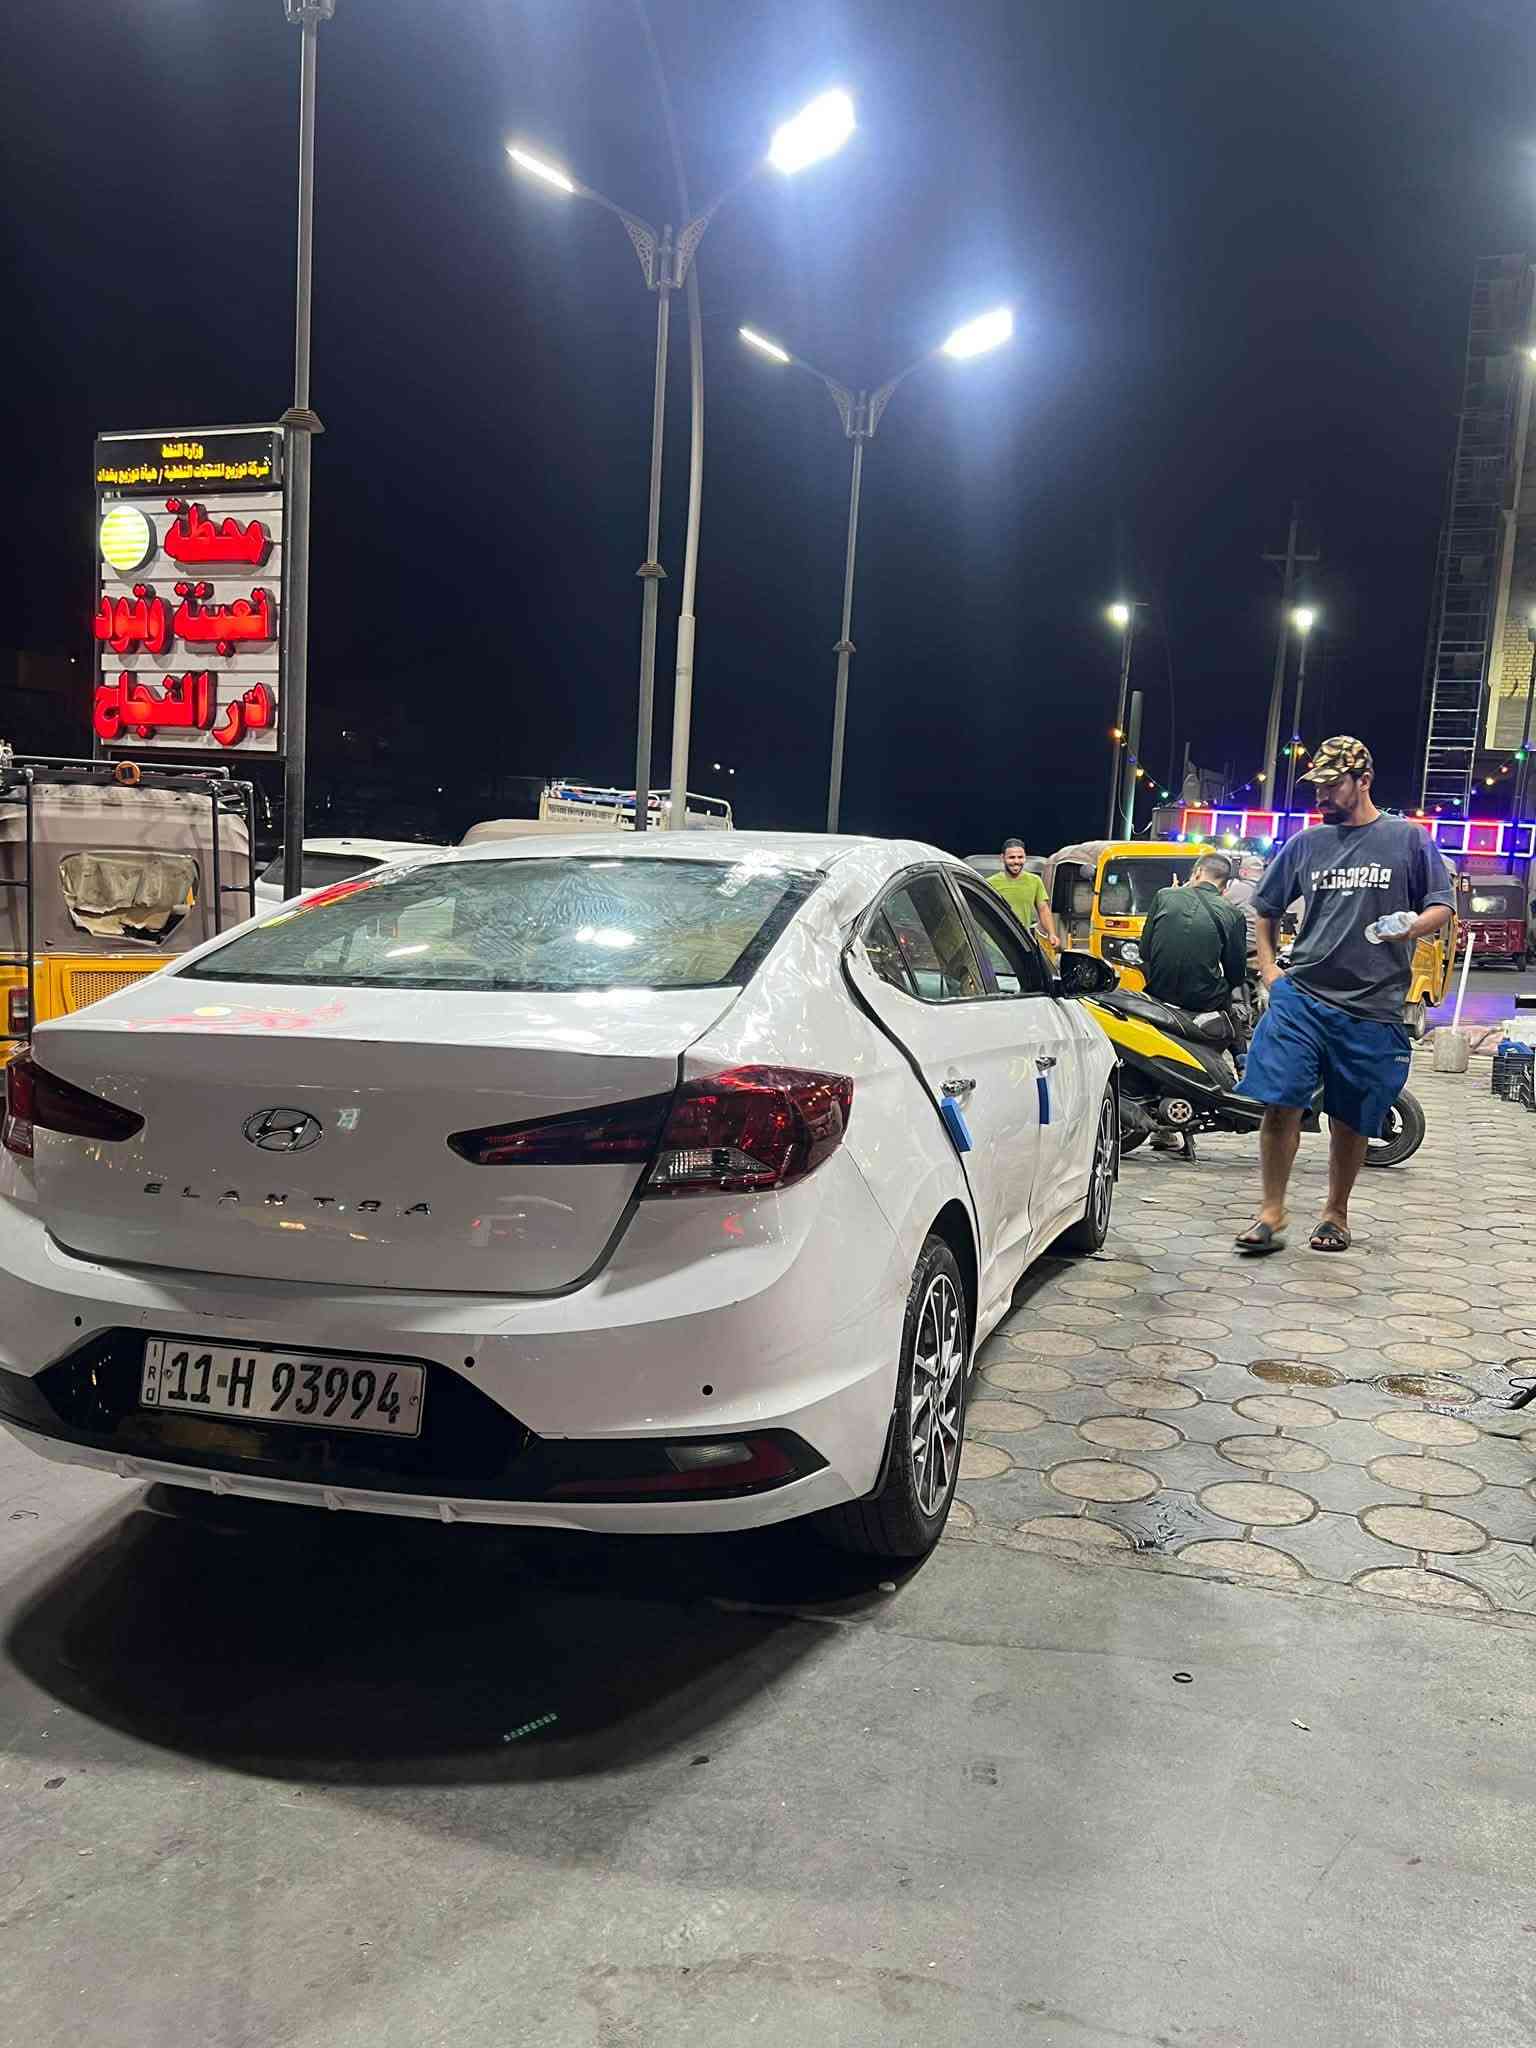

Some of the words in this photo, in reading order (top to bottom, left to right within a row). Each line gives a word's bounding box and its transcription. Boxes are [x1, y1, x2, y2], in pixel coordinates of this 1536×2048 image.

[162, 443, 184, 459] النفط
[184, 443, 204, 460] وزارة
[97, 468, 119, 484] بغداد
[119, 467, 140, 485] توزيع
[225, 462, 248, 480] توزيع
[248, 458, 271, 478] شركة
[164, 498, 265, 565] محطة
[93, 584, 165, 653] وقود
[173, 581, 269, 658] تعبئة
[93, 670, 212, 739] النجاح
[143, 1182, 432, 1216] ELANTRA
[270, 1362, 401, 1424] 93994
